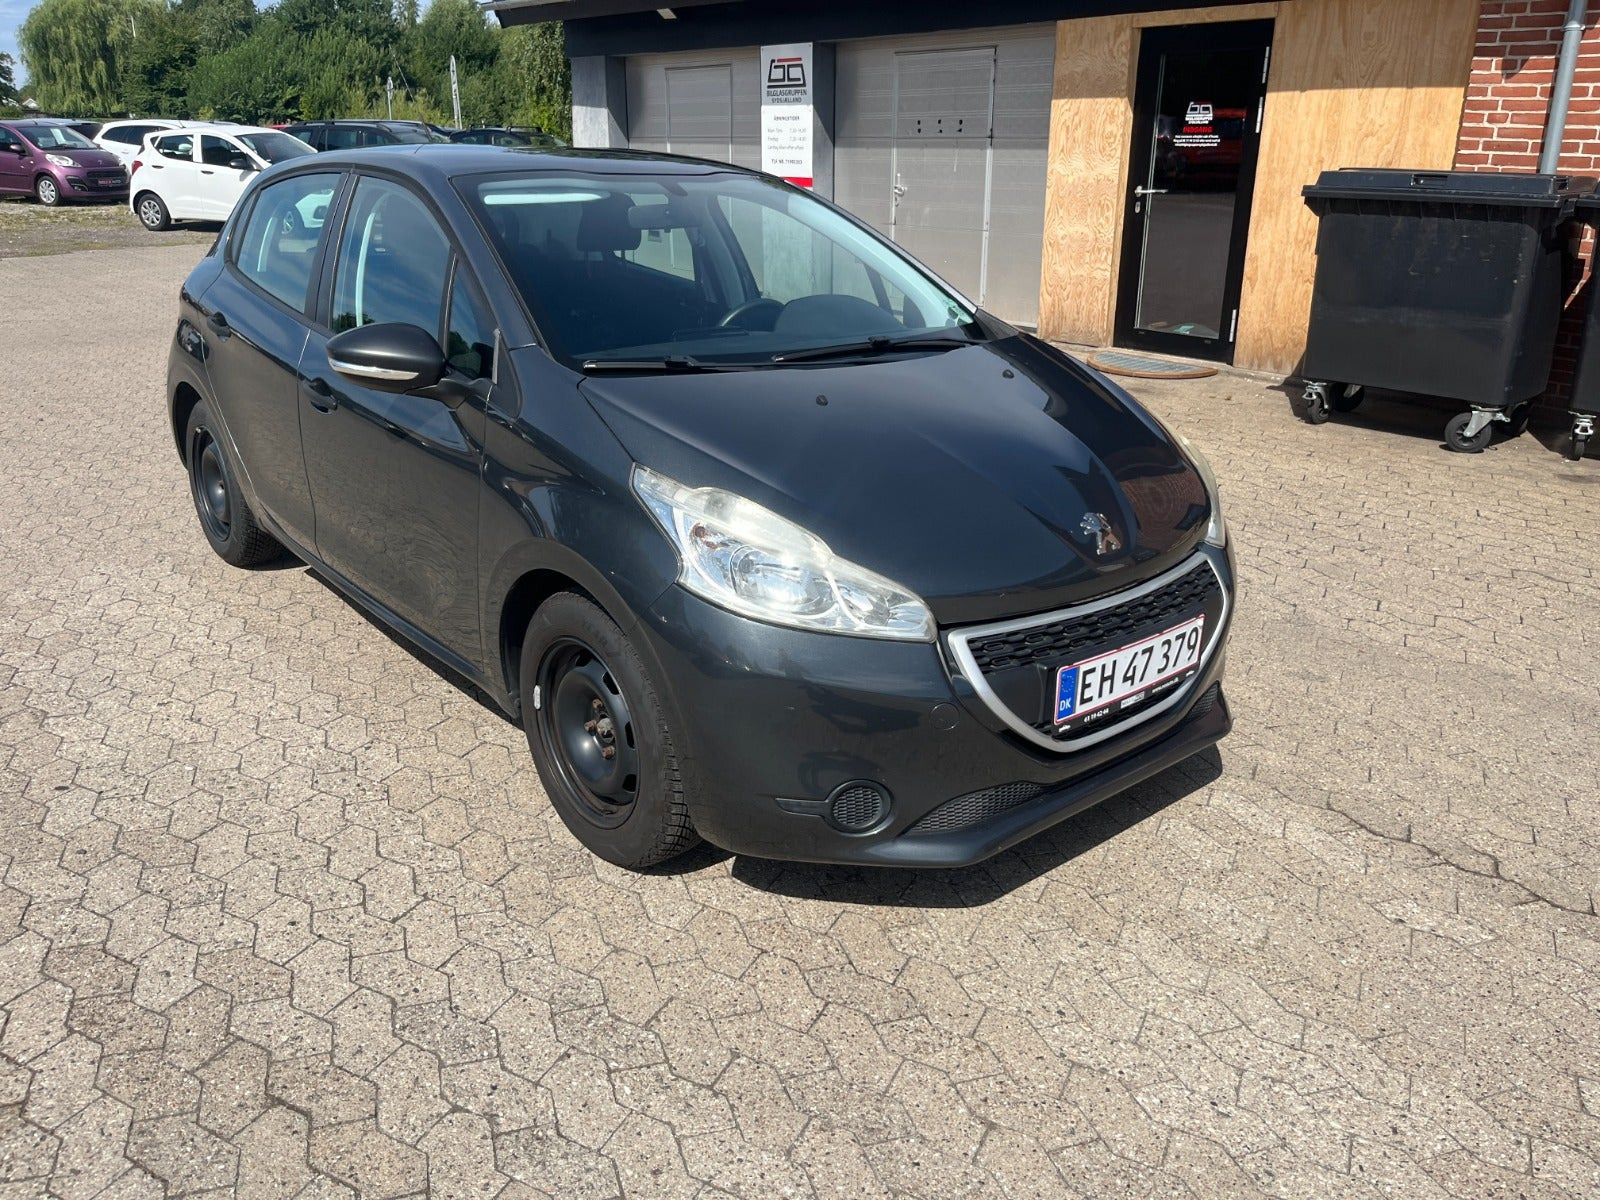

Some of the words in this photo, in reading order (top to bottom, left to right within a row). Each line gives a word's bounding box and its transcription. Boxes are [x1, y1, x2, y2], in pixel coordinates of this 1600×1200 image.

[1079, 659, 1117, 705] EH
[1122, 645, 1154, 686] 47
[1157, 626, 1199, 674] 379
[1059, 698, 1071, 711] DK
